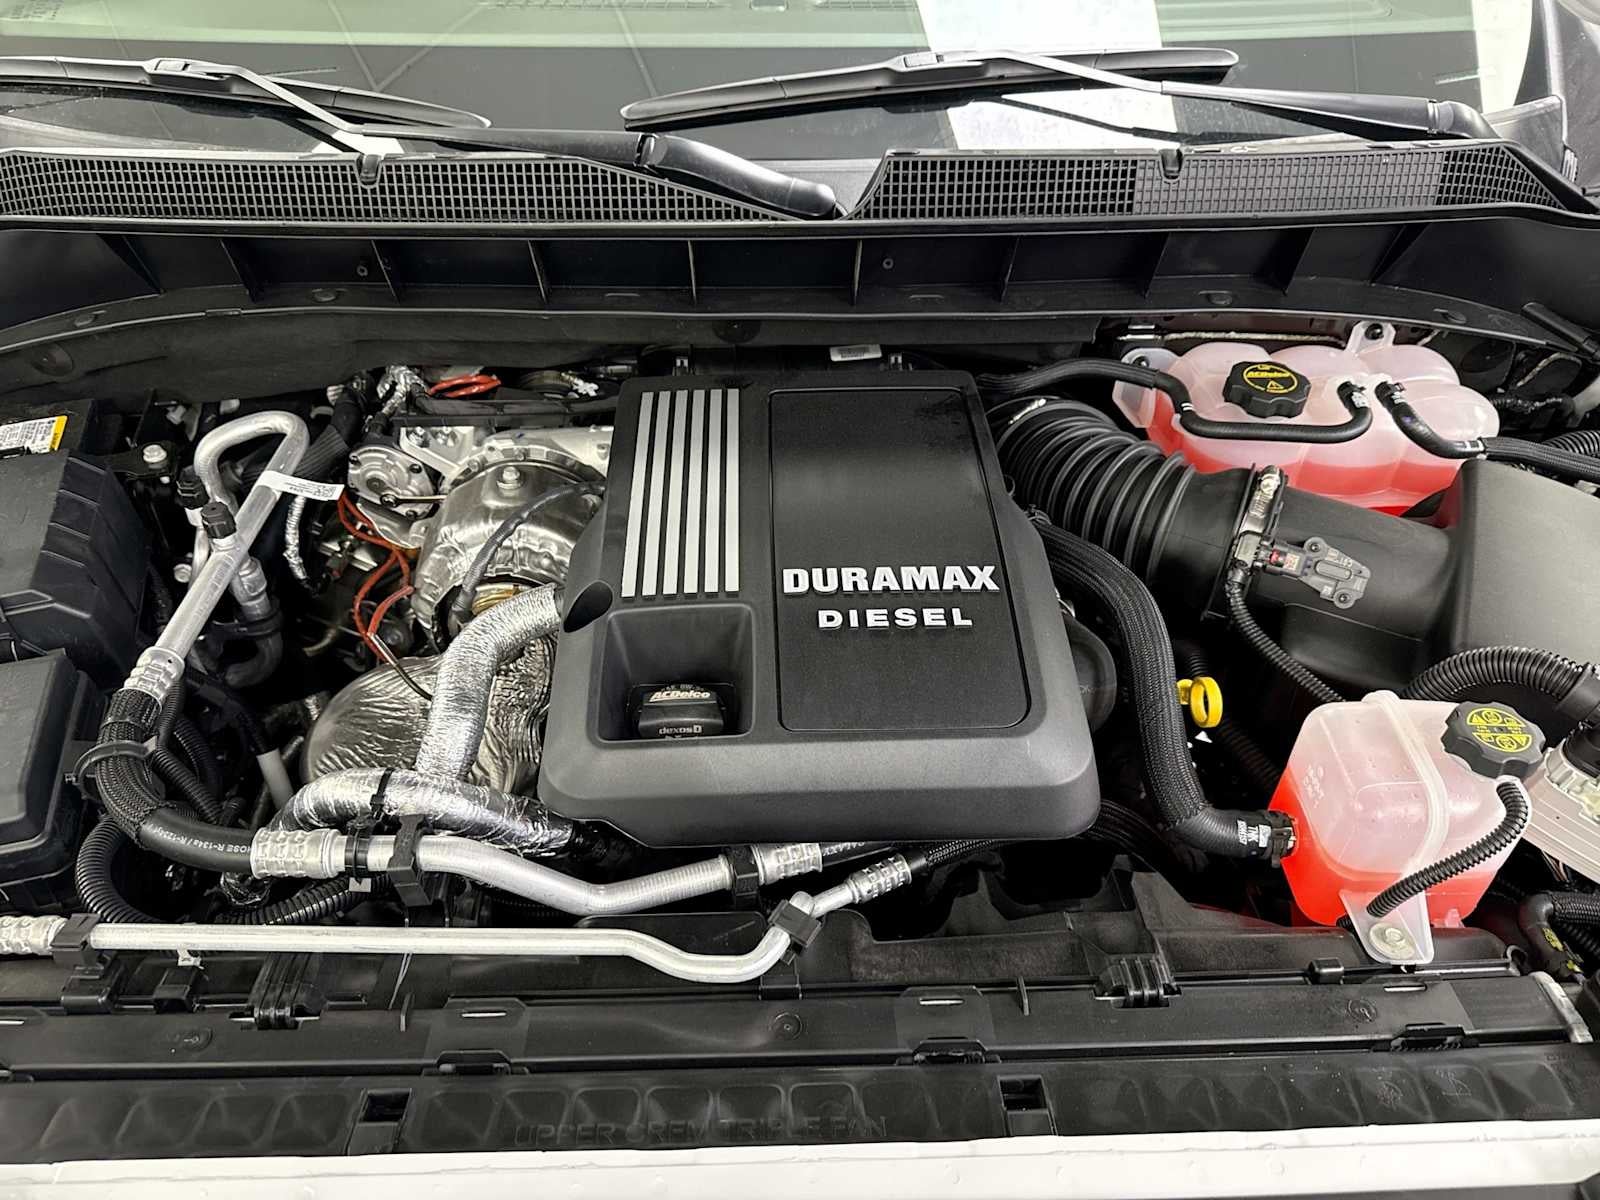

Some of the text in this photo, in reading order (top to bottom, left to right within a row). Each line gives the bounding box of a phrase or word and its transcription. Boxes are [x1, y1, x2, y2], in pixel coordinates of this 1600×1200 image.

[782, 565, 1000, 594] DURAMAX
[817, 607, 973, 629] DIESEL
[649, 690, 711, 702] ACDelco
